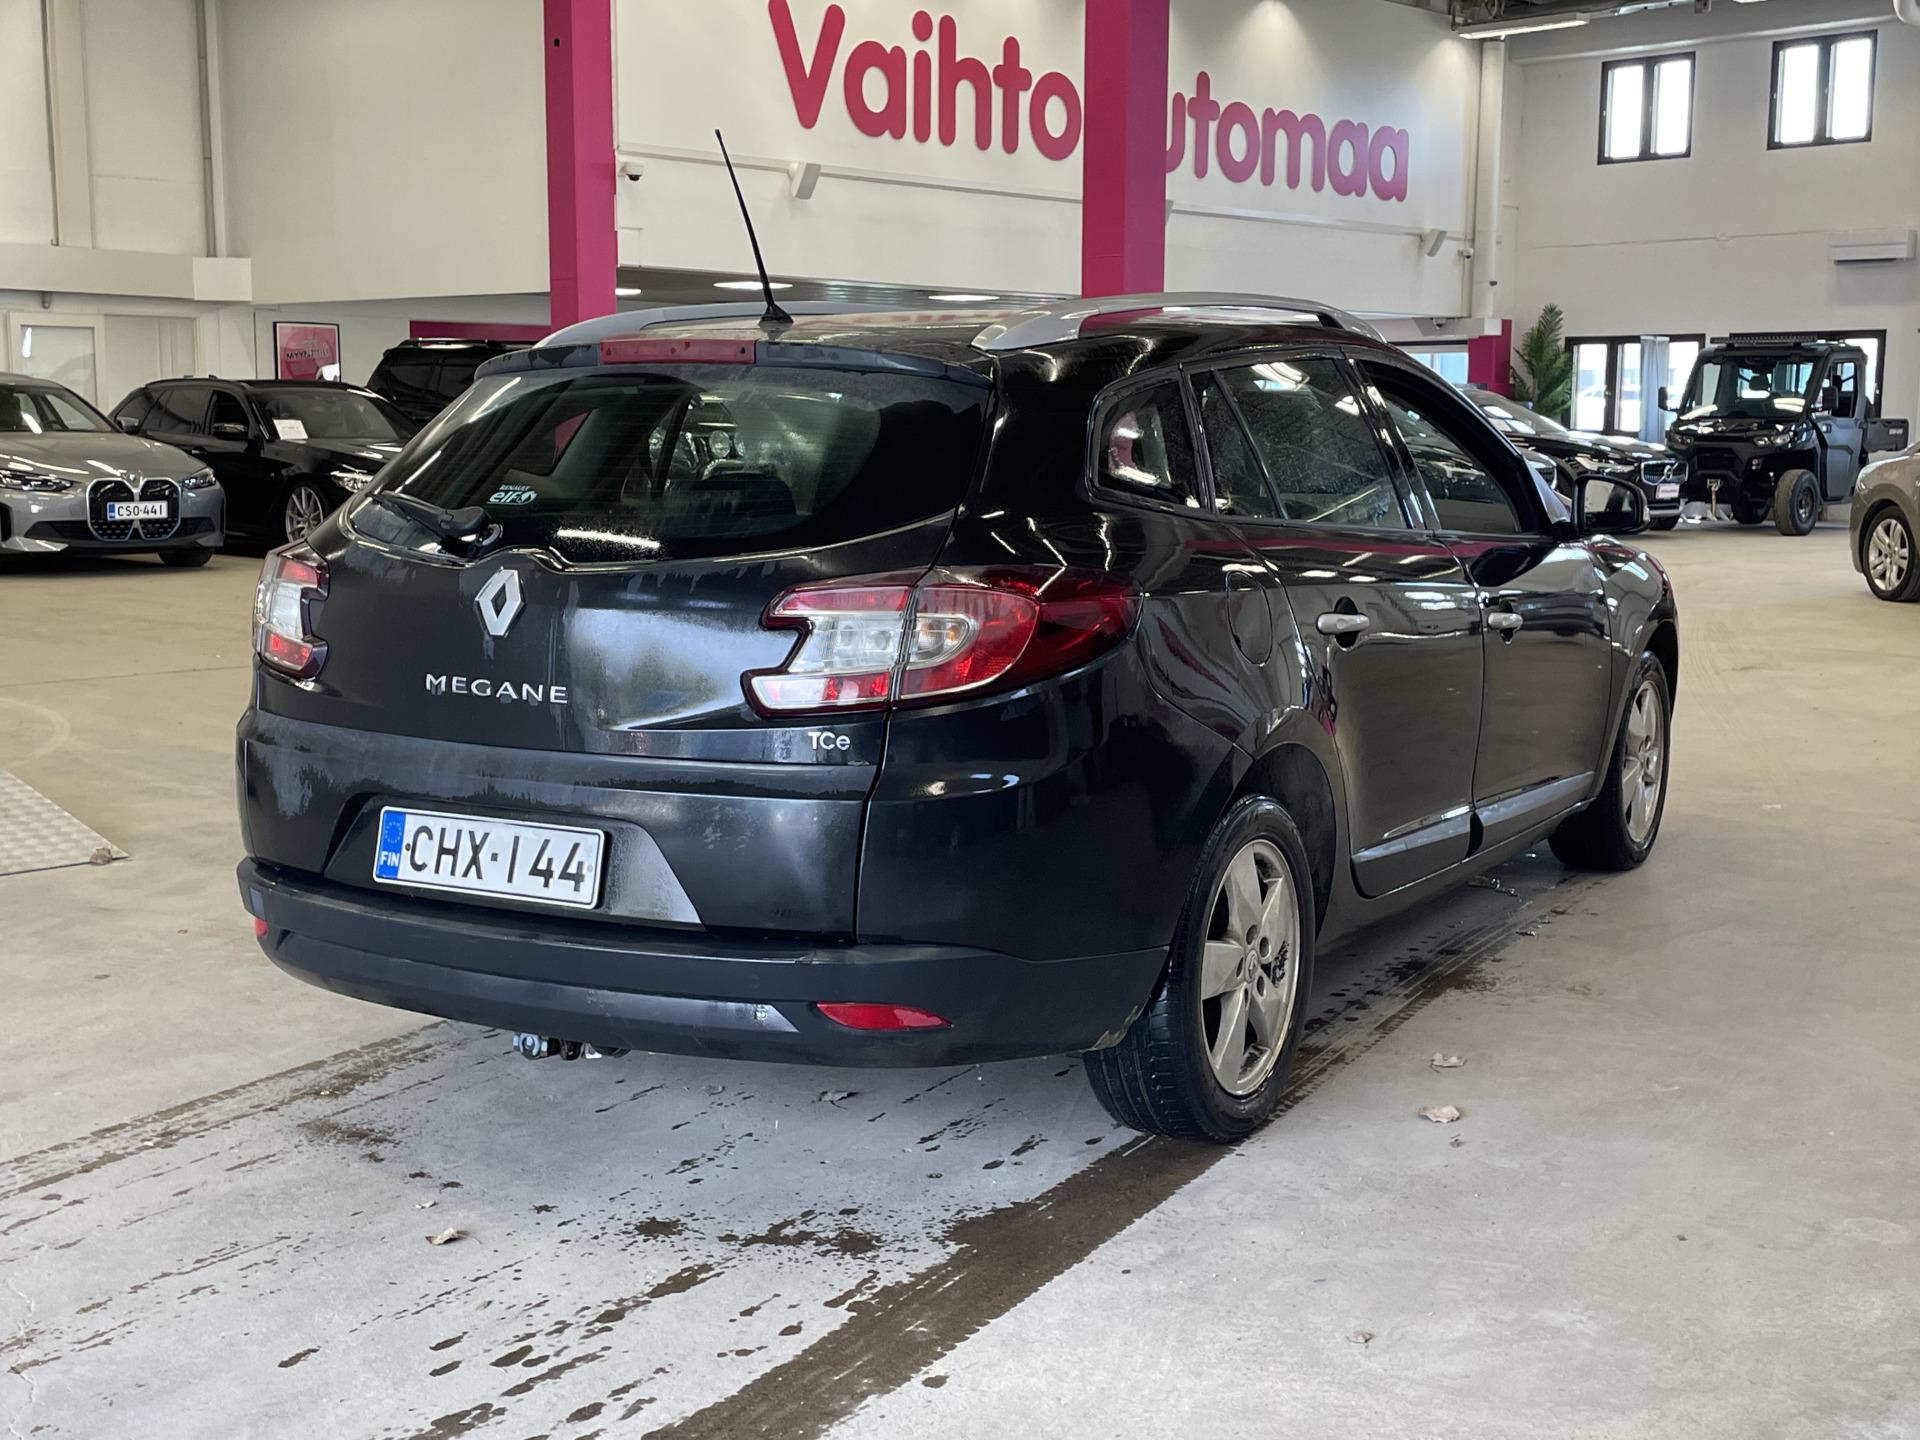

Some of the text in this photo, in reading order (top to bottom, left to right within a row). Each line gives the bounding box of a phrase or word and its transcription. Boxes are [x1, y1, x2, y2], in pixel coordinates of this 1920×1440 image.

[117, 504, 163, 517] CSO-441
[425, 673, 568, 704] MEGANE
[807, 731, 851, 751] TCe
[380, 825, 586, 893] FIN CHX-144
